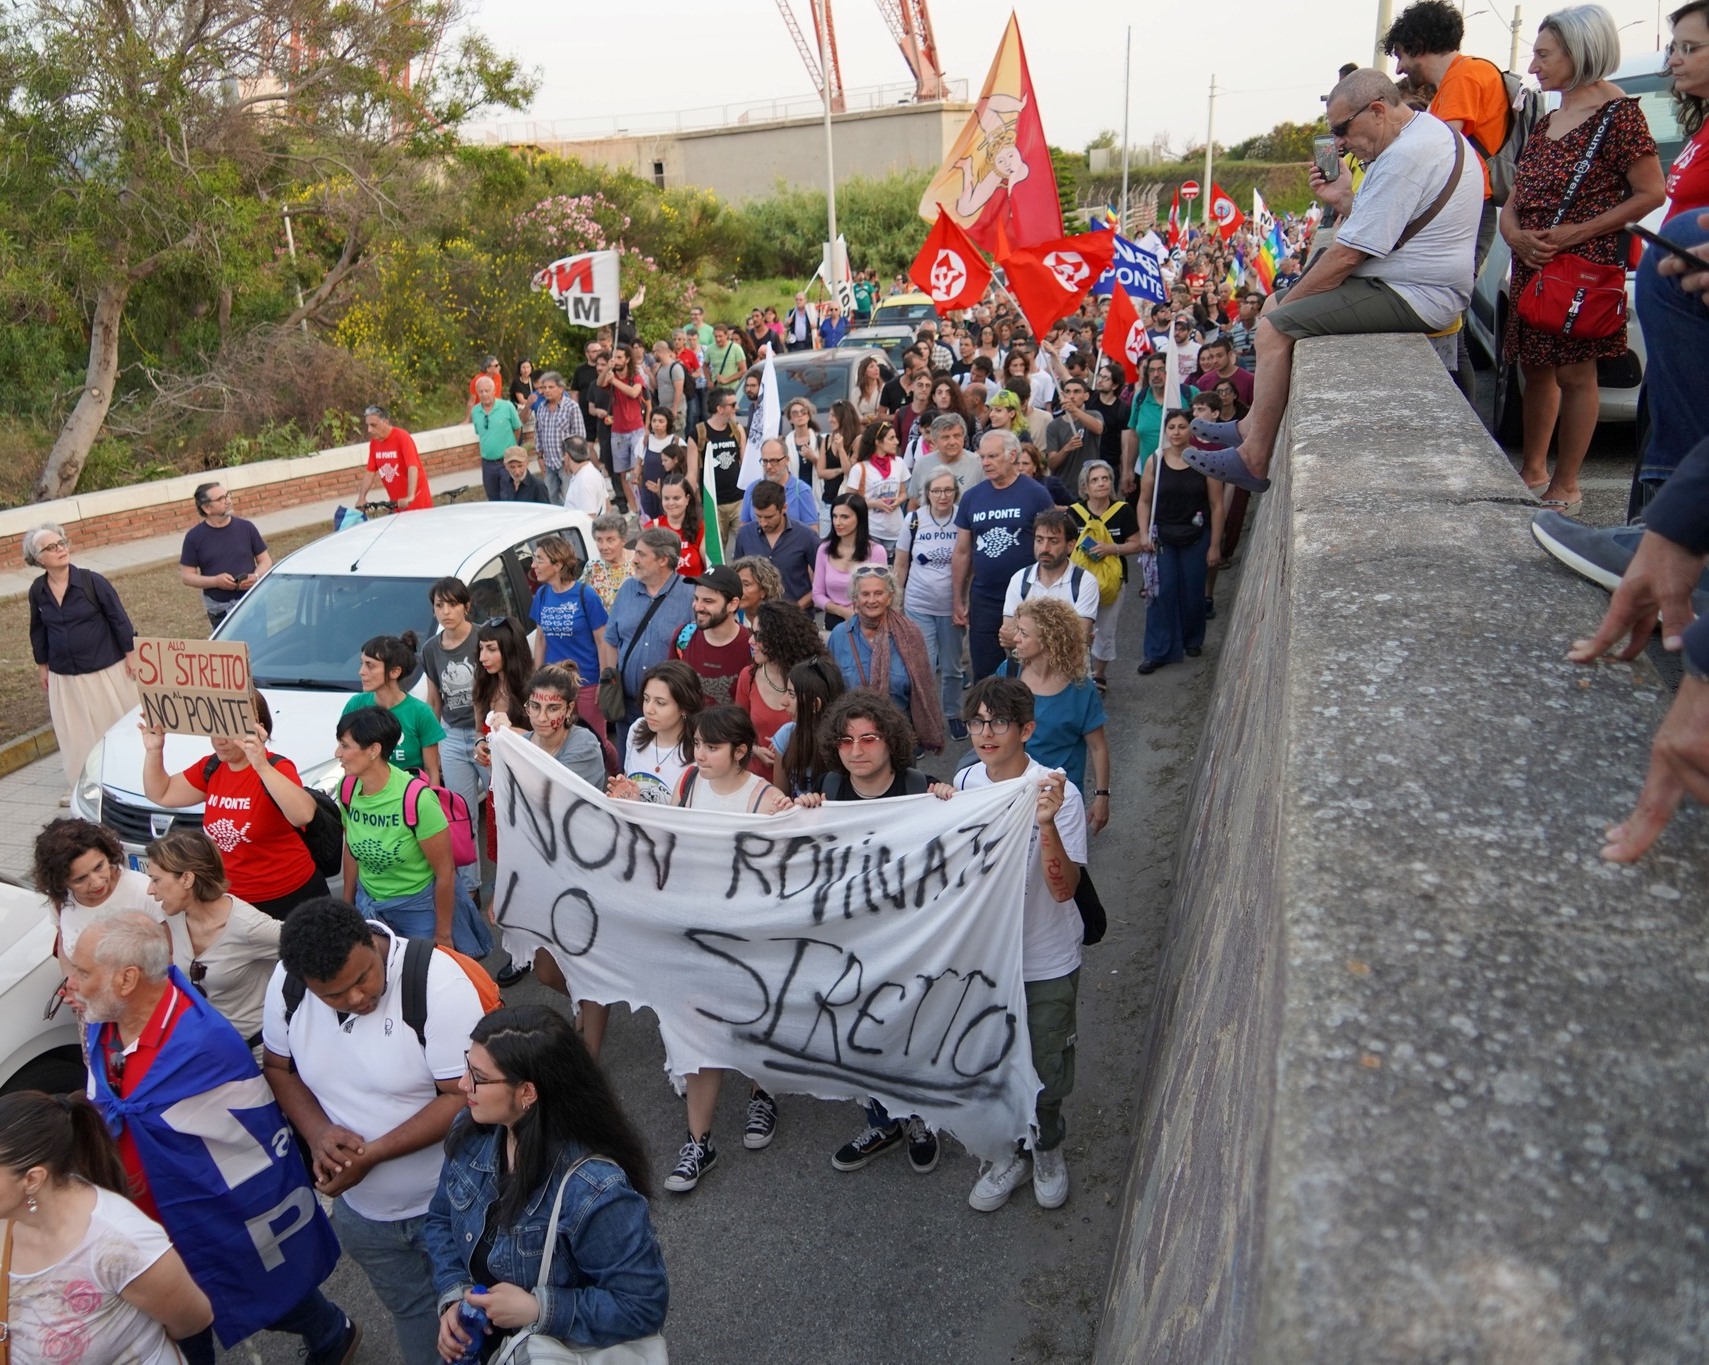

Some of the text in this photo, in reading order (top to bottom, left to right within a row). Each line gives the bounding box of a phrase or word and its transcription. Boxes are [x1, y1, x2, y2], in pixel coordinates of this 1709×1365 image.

[1100, 267, 1163, 300] PONTE
[973, 508, 1020, 522] NO PONTE
[934, 532, 958, 540] PONT
[168, 641, 185, 651] ALLO
[175, 653, 245, 690] STRETTO
[143, 691, 256, 736] NO AL PONTE
[219, 796, 250, 810] PONTE
[363, 813, 399, 827] PONTE
[502, 763, 676, 890] NON
[496, 871, 598, 956] LO
[685, 928, 1017, 1077] STRETTO
